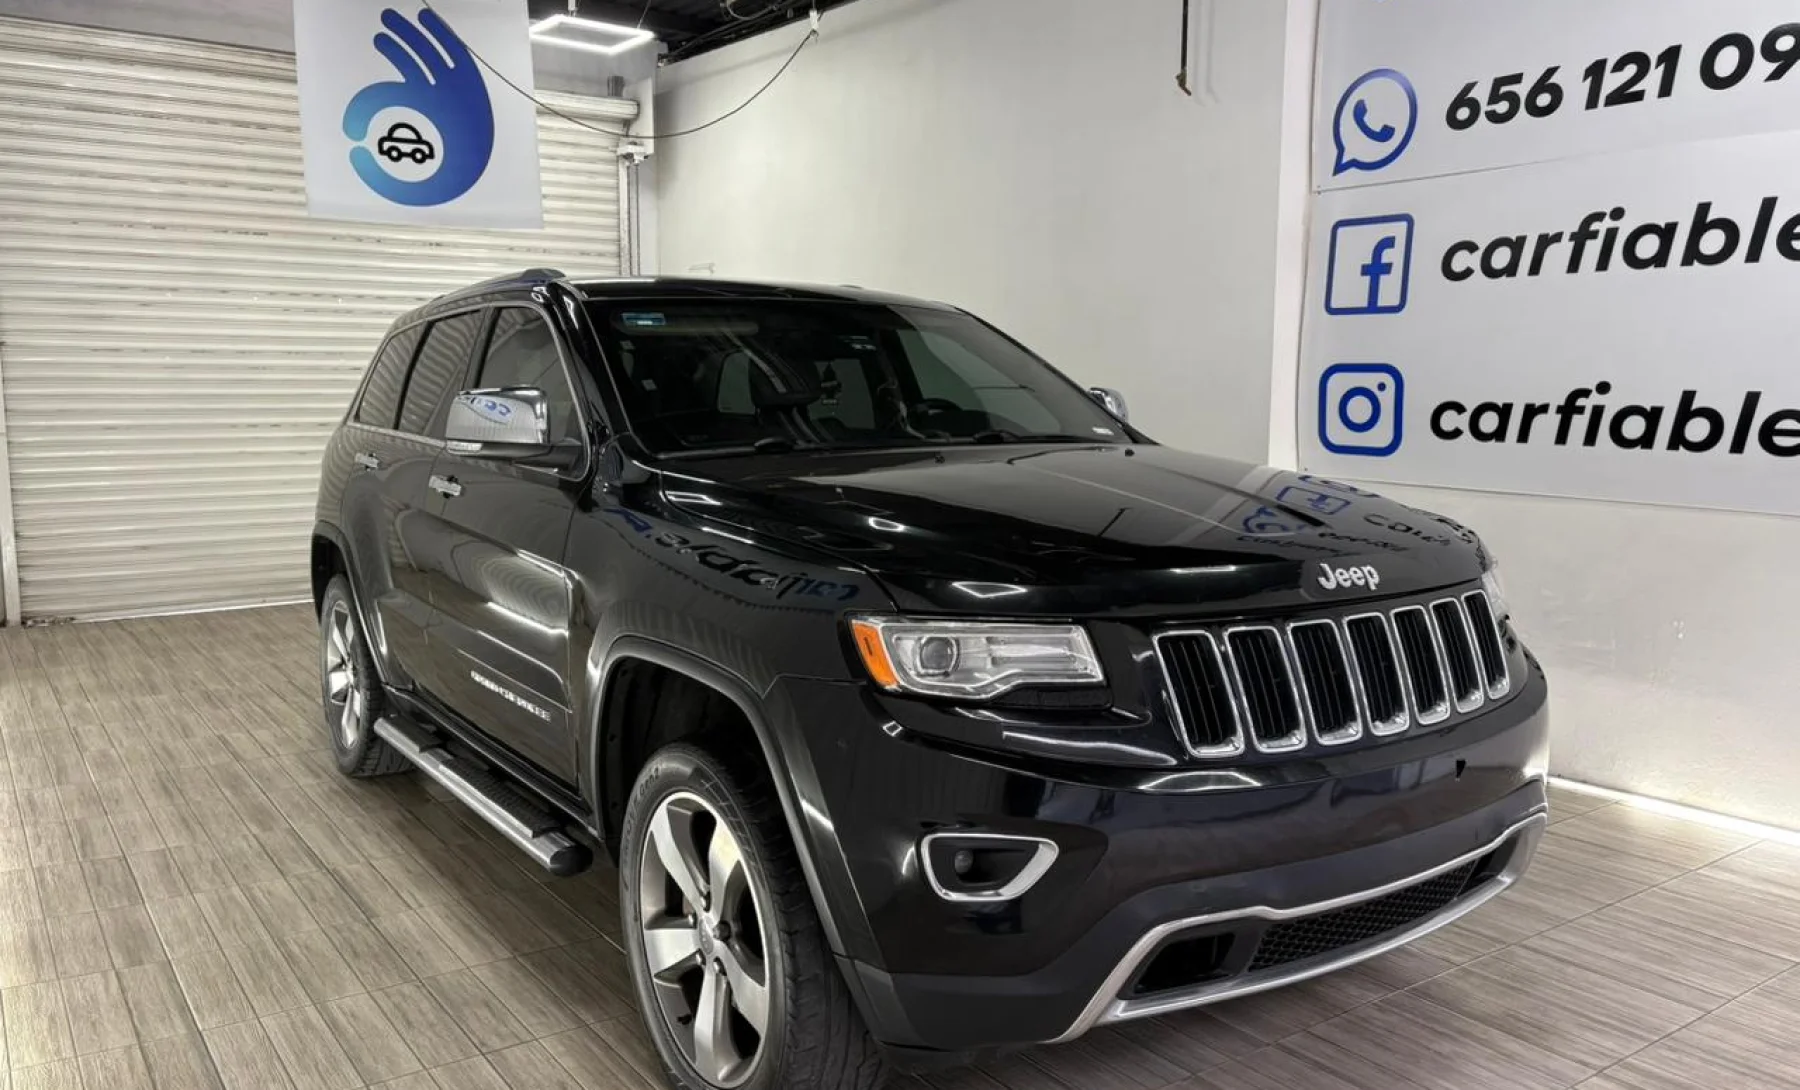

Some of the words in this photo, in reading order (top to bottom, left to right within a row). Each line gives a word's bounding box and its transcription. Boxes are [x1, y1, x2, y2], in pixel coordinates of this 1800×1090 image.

[1446, 65, 1564, 131] 656
[1582, 44, 1683, 111] 121
[1699, 22, 1800, 91] 09
[1429, 380, 1800, 458] carfiable
[1317, 562, 1381, 591] Jeep
